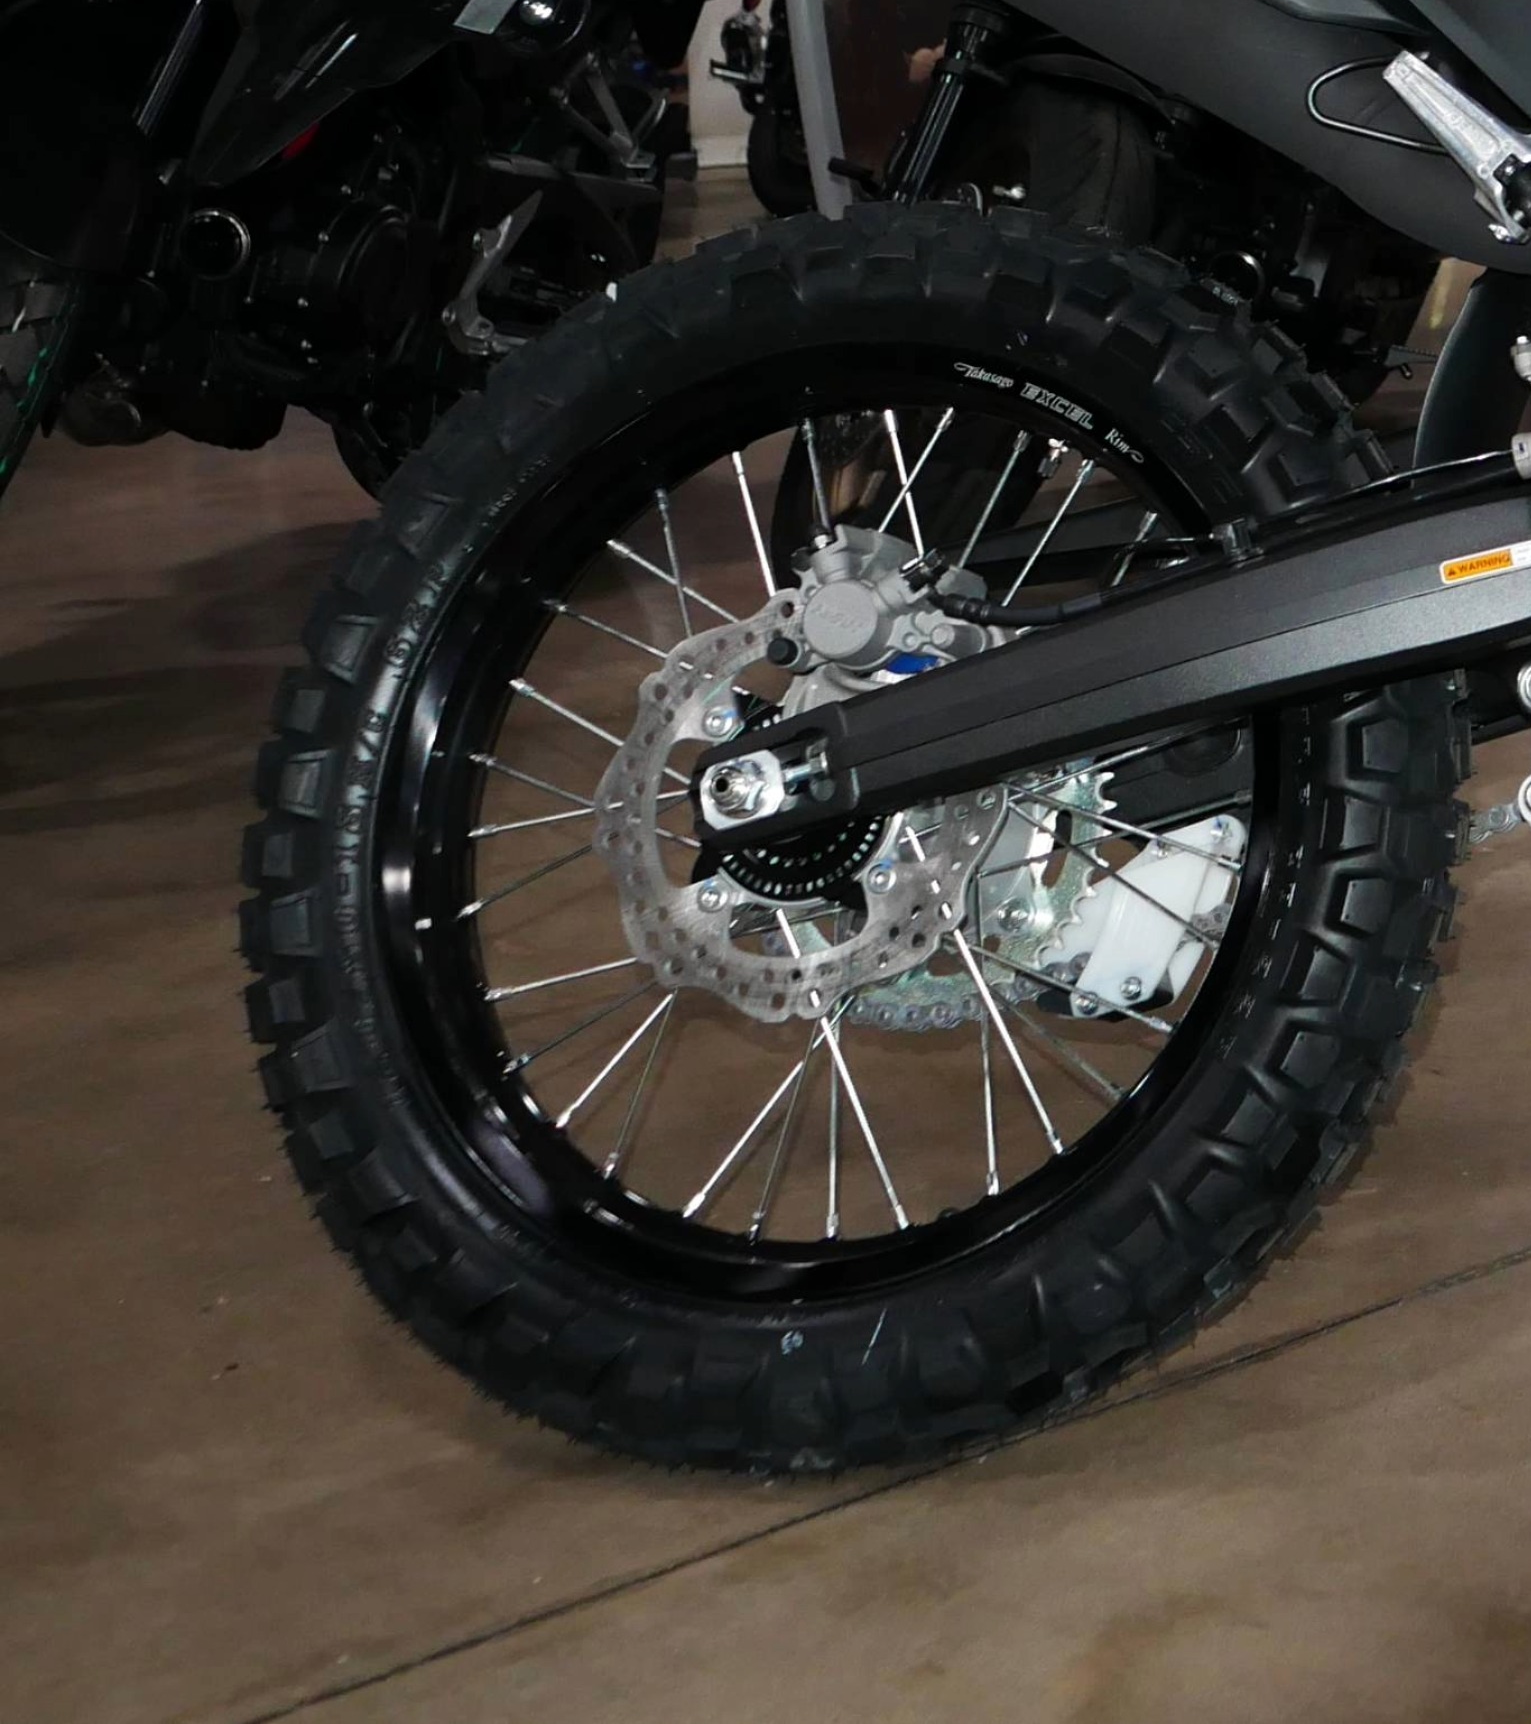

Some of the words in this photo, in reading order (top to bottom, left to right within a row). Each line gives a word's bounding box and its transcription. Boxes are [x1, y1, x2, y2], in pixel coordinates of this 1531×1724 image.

[1020, 382, 1093, 430] EXCEL
[1104, 428, 1145, 464] Rim
[1459, 554, 1511, 574] WARNING
